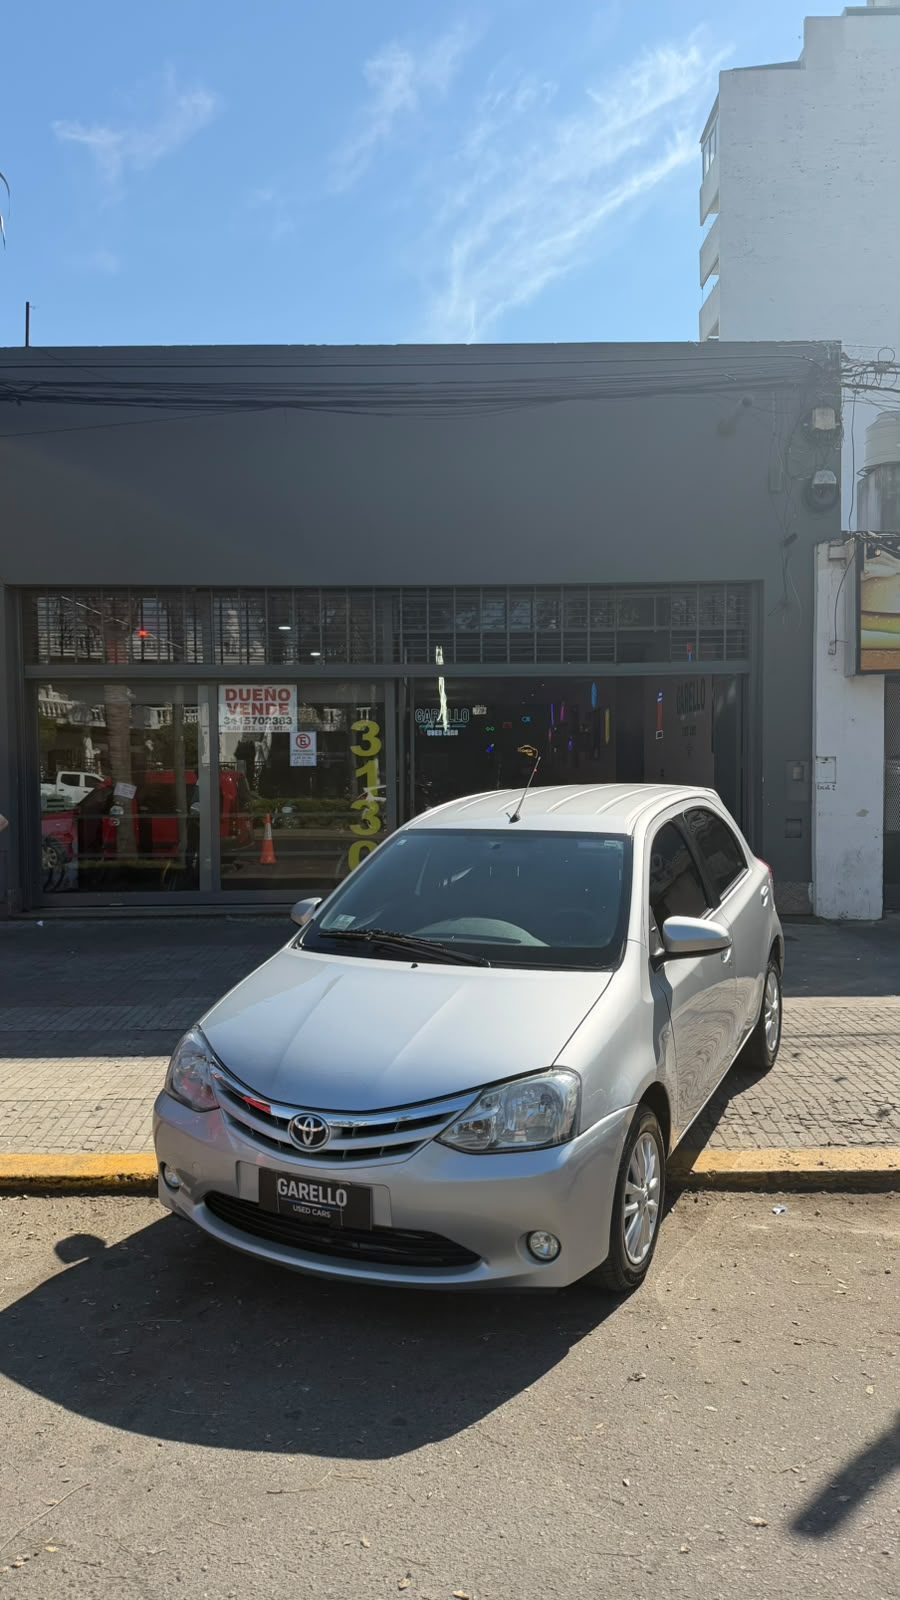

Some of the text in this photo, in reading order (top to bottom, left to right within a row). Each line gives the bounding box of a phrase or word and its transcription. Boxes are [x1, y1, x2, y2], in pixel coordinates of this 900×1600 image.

[225, 686, 291, 702] DUEÑO
[226, 702, 289, 716] VENDE
[277, 1178, 348, 1207] GARELLO
[293, 1204, 331, 1218] USED CARS
